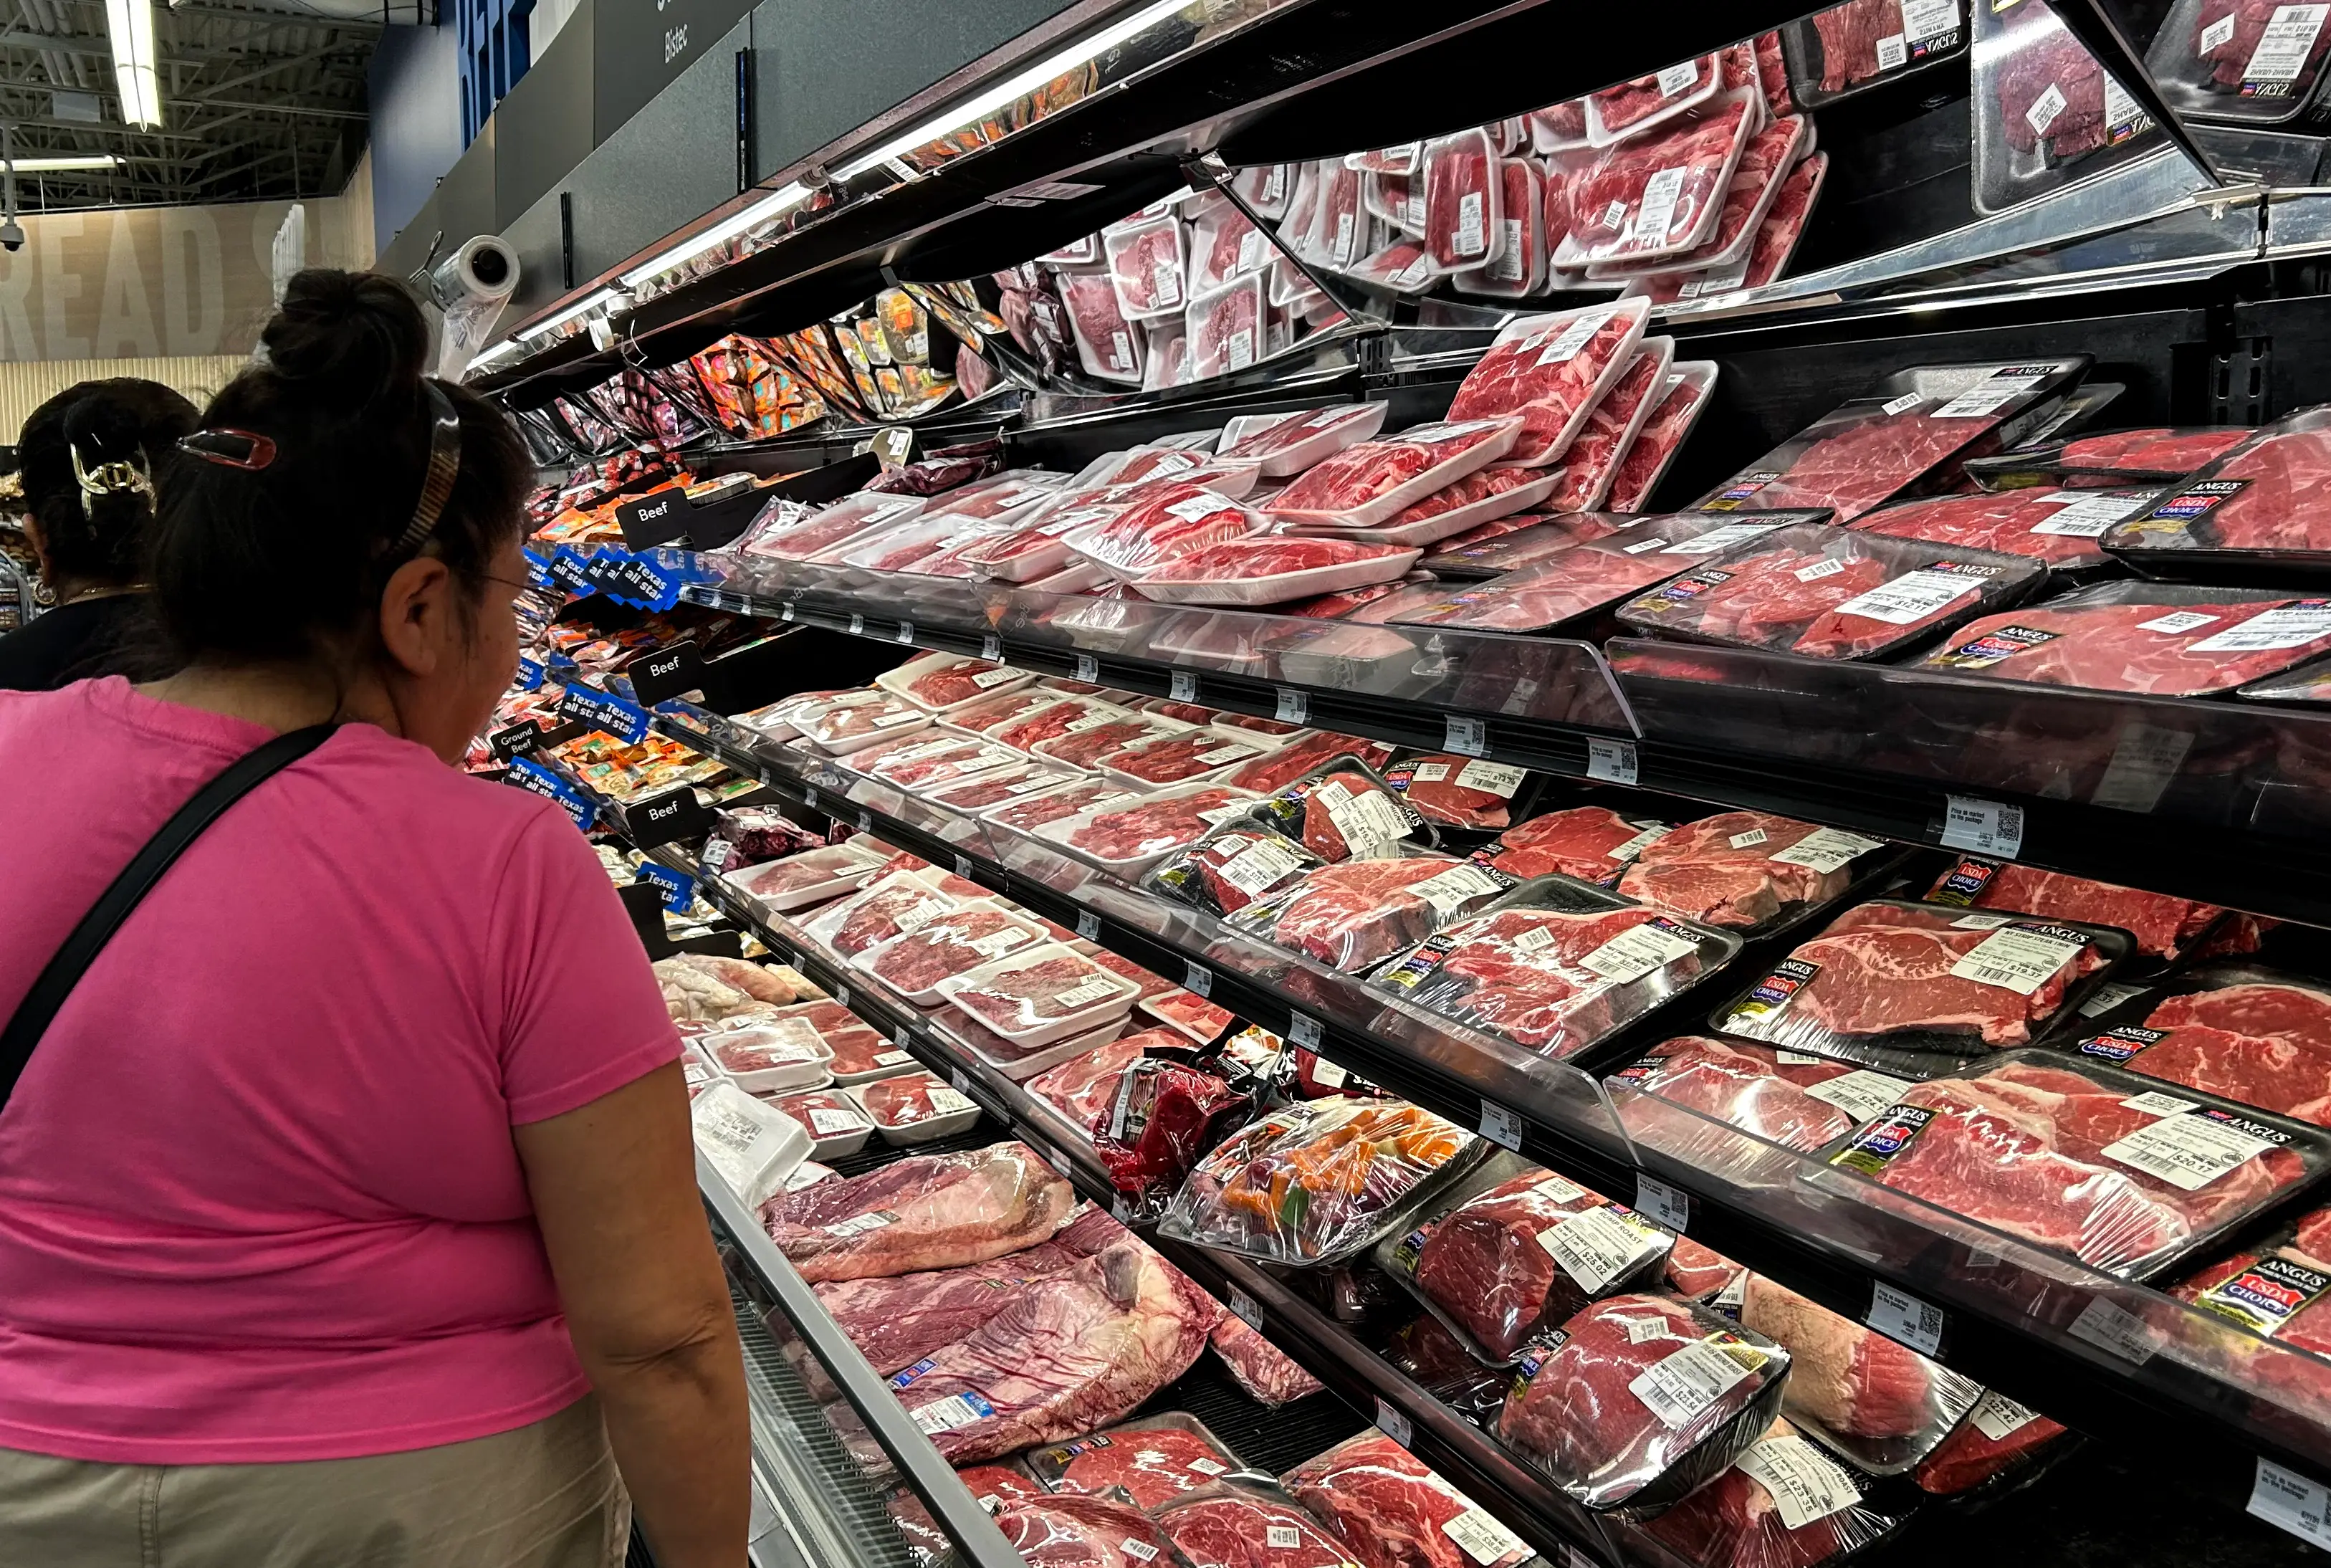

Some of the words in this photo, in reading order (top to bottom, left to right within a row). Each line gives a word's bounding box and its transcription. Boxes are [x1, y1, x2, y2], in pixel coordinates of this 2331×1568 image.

[665, 24, 688, 64] Bistec
[2189, 482, 2243, 491] ANGUS
[638, 501, 668, 522] Beef
[2159, 506, 2205, 515] CHOICE
[553, 564, 568, 576] all
[567, 573, 589, 589] star
[636, 561, 668, 591] Texas
[1947, 564, 2002, 575] ANGUS
[624, 570, 642, 585] all
[638, 580, 663, 601] star
[2004, 627, 2054, 641] ANGUS
[649, 656, 680, 678] Beef
[564, 701, 578, 713] all
[606, 702, 638, 725] Texas
[596, 710, 613, 725] all
[612, 719, 636, 737] star
[501, 726, 533, 746] Ground
[511, 738, 532, 754] Beef
[509, 770, 522, 780] all
[526, 780, 538, 792] all
[557, 795, 585, 814] Texas
[648, 800, 679, 821] Beef
[1390, 805, 1407, 829] MIGNON
[648, 871, 679, 891] Texas
[1482, 866, 1514, 887] ANGUS
[1951, 874, 1981, 887] CHOICE
[1961, 866, 1983, 879] USDA
[2014, 932, 2034, 941] STRIP
[2033, 935, 2054, 945] STEAK
[2036, 924, 2090, 944] ANGUS
[1781, 961, 1814, 975] ANGUS
[2008, 965, 2042, 979] $19.37
[1756, 987, 1788, 1000] CHOICE
[1766, 980, 1790, 992] USDA
[2112, 1027, 2163, 1039] ANGUS
[2087, 1043, 2132, 1056] CHOICE
[2101, 1039, 2133, 1051] USDA
[2226, 1117, 2292, 1143] ANGUS
[2172, 1155, 2213, 1174] $20.17
[1599, 1211, 1620, 1227] RUMP
[1618, 1225, 1643, 1245] ROAST
[1581, 1251, 1607, 1276] $25.02
[2263, 1261, 2327, 1287] ANGUS
[2229, 1285, 2287, 1313] CHOICE
[2246, 1279, 2289, 1304] USDA
[1713, 1352, 1728, 1367] ROUND
[1728, 1363, 1743, 1375] ROAST
[1988, 1399, 2016, 1425] $22.42
[1817, 1456, 1837, 1475] ROUND
[1836, 1473, 1854, 1494] ROAST
[1789, 1480, 1814, 1513] $23.35
